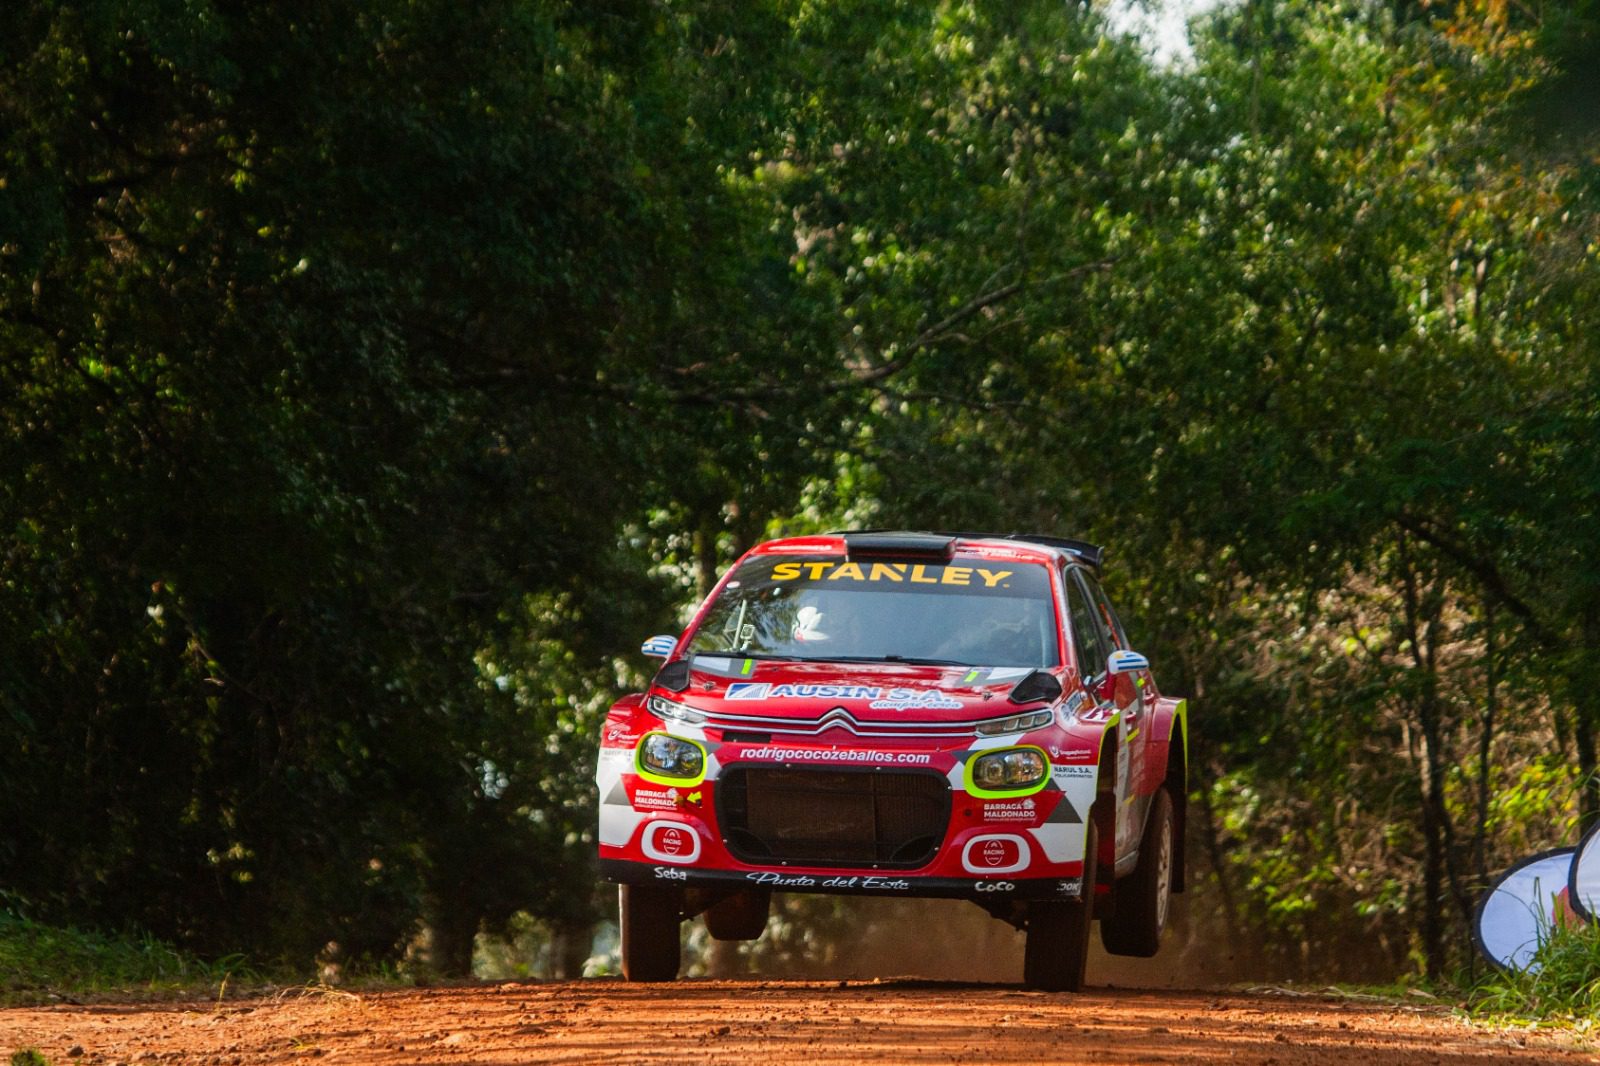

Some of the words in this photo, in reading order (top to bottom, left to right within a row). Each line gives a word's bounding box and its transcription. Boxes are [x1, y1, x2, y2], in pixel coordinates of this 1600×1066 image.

[771, 561, 1013, 588] STANLEY
[771, 684, 880, 699] AUSIN
[889, 687, 953, 704] S.A.
[739, 747, 931, 764] rodrigococozeballos.com
[635, 789, 666, 799] BARRACA
[983, 803, 1023, 811] BARRACA
[983, 810, 1036, 818] MALDONADO
[653, 866, 687, 881] Seba
[746, 872, 816, 888] Punta
[822, 875, 857, 889] del
[861, 876, 910, 891] Este
